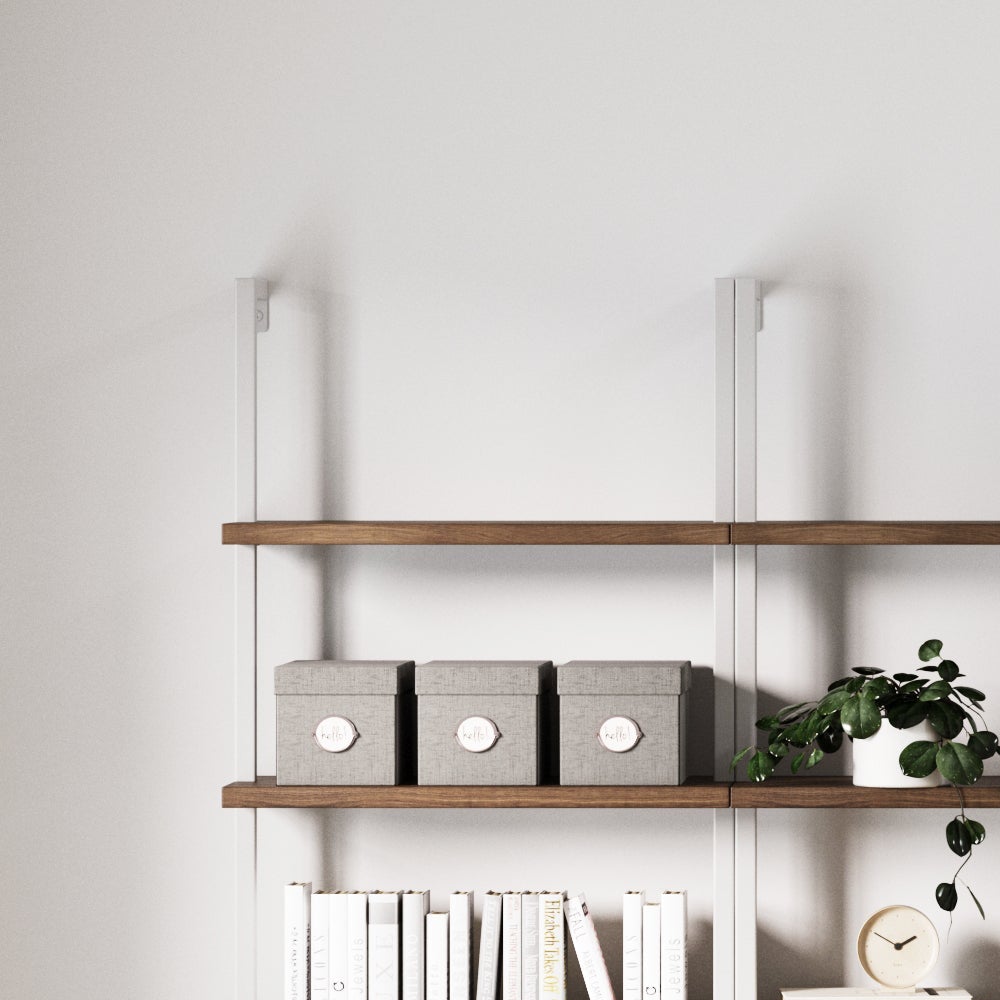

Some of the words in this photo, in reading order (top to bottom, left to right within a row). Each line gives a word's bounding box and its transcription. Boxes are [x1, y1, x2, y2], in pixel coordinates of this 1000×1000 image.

[543, 899, 561, 946] Elizabeth
[570, 912, 587, 942] FALL
[350, 937, 364, 994] Jewels
[543, 948, 560, 974] Takes
[664, 937, 681, 994] Jewels
[543, 975, 560, 994] Off
